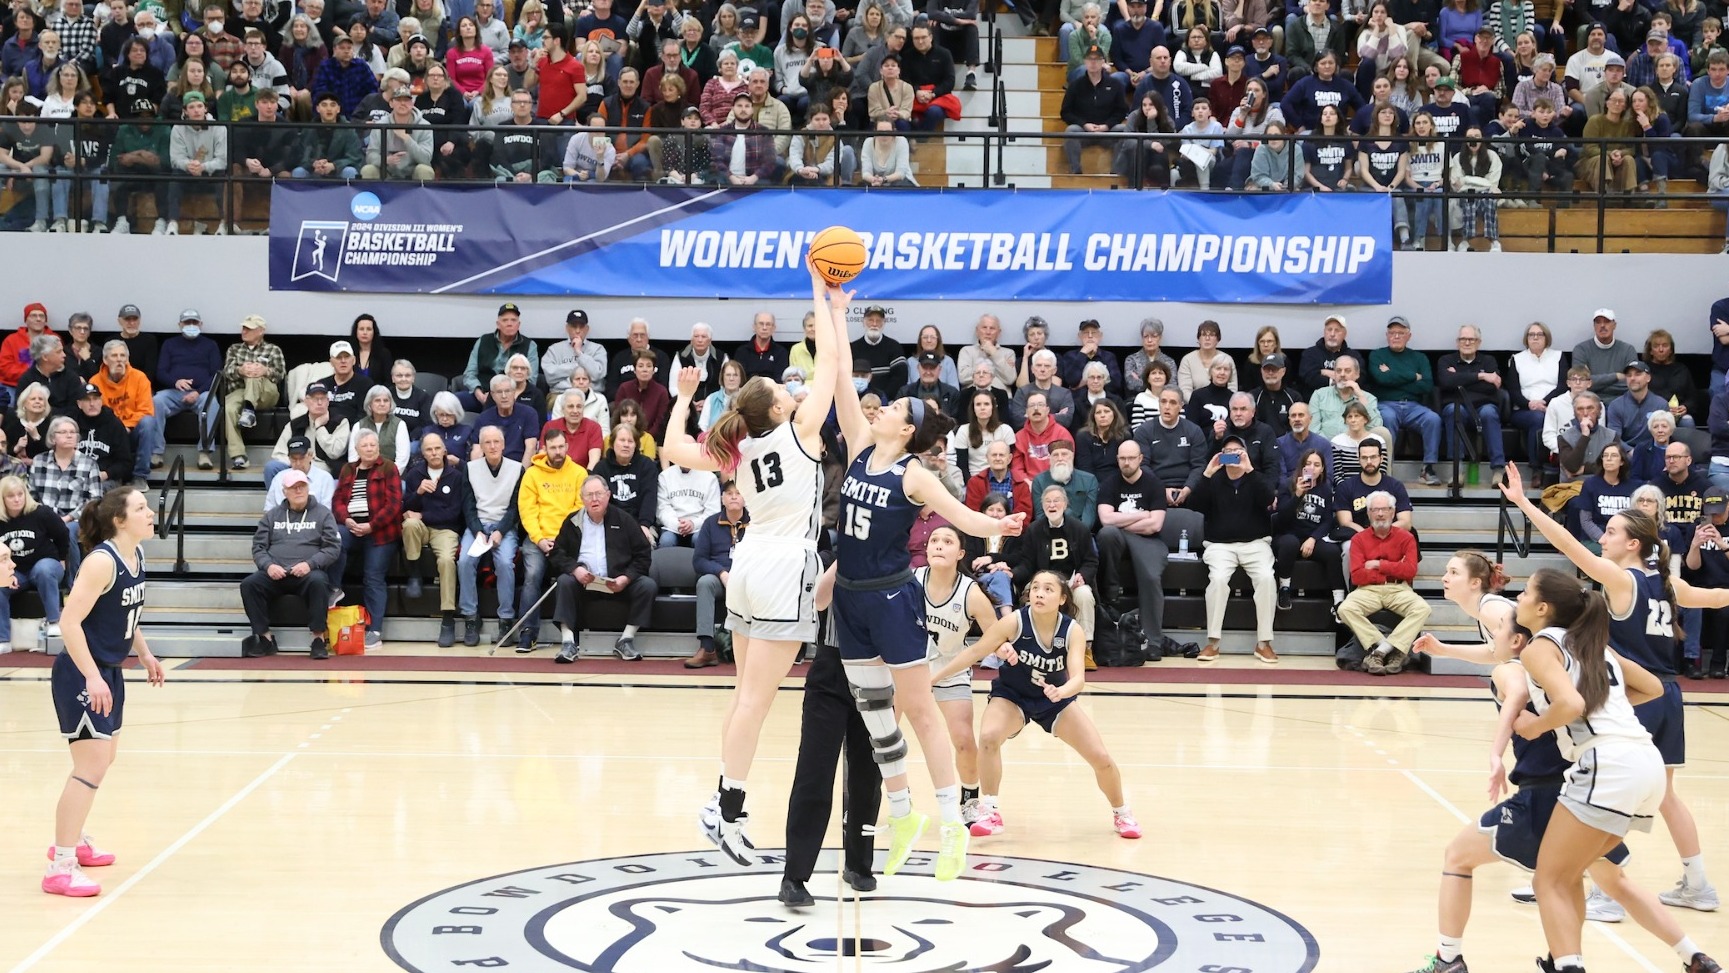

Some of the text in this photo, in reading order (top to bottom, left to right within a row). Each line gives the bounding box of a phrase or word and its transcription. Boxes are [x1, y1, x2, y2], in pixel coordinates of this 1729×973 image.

[1315, 91, 1341, 101] SMITH
[504, 134, 533, 145] BOWDOI
[1317, 147, 1345, 158] SMITH
[1371, 152, 1399, 163] SMITH
[1410, 153, 1440, 164] SMITH
[1320, 157, 1343, 165] ENERGY
[354, 204, 380, 214] NCAA
[351, 222, 463, 233] 2024 DIVISION III WOMEN'S
[347, 231, 455, 252] BASKETBALL
[344, 251, 437, 266] CHAMPIONSHIP
[659, 228, 817, 269] WOMEN'
[1083, 232, 1376, 274] CHAMPIONSHIP
[750, 451, 784, 494] 13
[670, 488, 705, 501] BOWDOIN
[840, 475, 892, 509] SMITH
[1597, 494, 1631, 508] SMITH
[1665, 494, 1703, 510] MITH
[273, 521, 317, 530] BOWDOIN
[844, 502, 873, 541] 15
[1050, 537, 1069, 561] B
[121, 581, 146, 607] SMIT
[1645, 597, 1674, 638] 22
[1018, 649, 1065, 672] SMITH
[1030, 668, 1048, 687] 5
